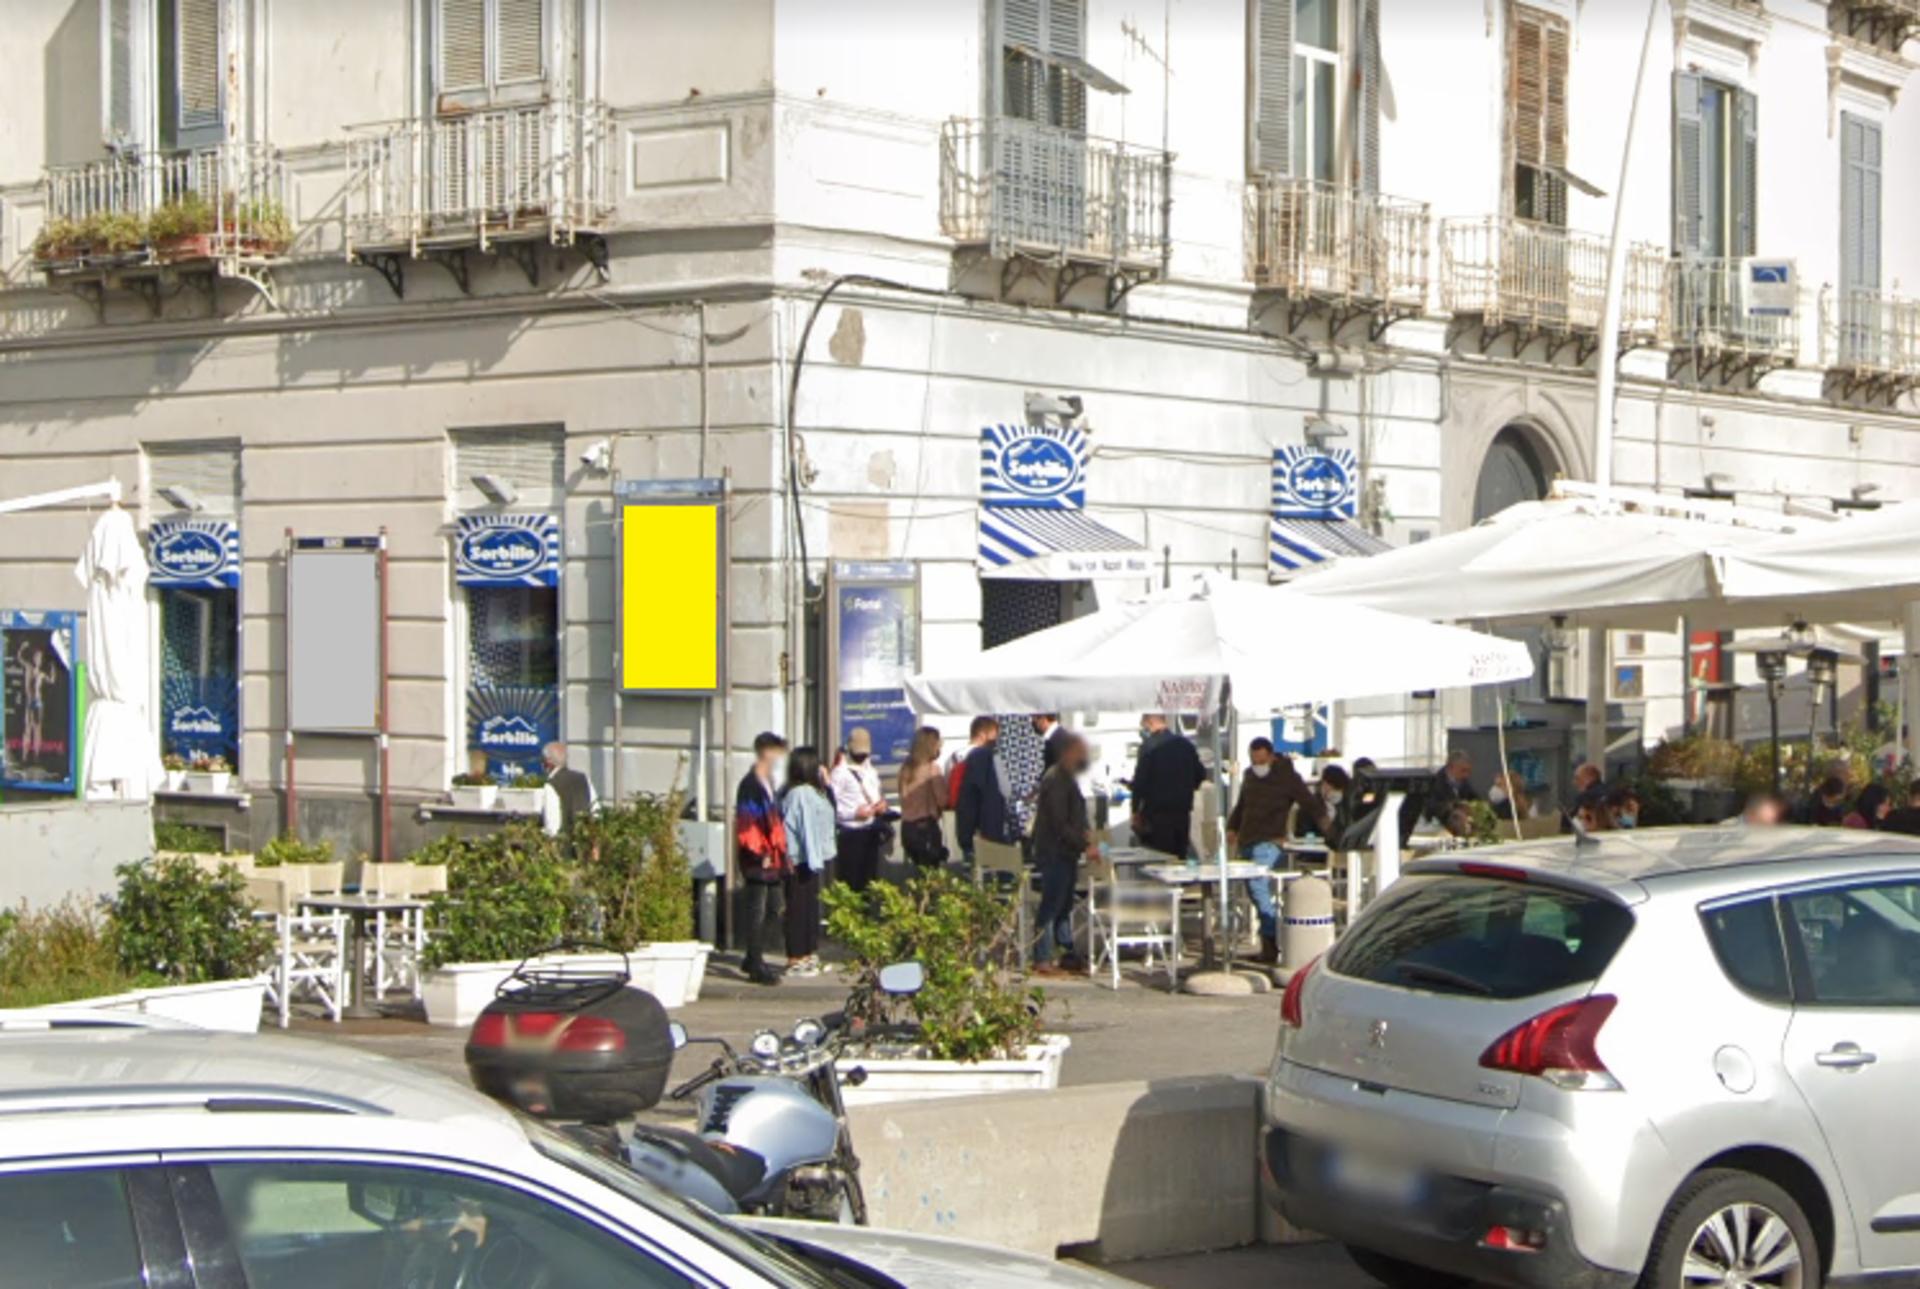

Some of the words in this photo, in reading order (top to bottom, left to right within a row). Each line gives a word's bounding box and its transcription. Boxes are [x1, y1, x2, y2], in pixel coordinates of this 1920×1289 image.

[1009, 459, 1068, 478] Sorbillo
[161, 547, 217, 563] Sorbillo
[469, 544, 536, 561] Sorbillo
[172, 718, 222, 732] Sorbillo
[481, 730, 539, 745] Sorbillo
